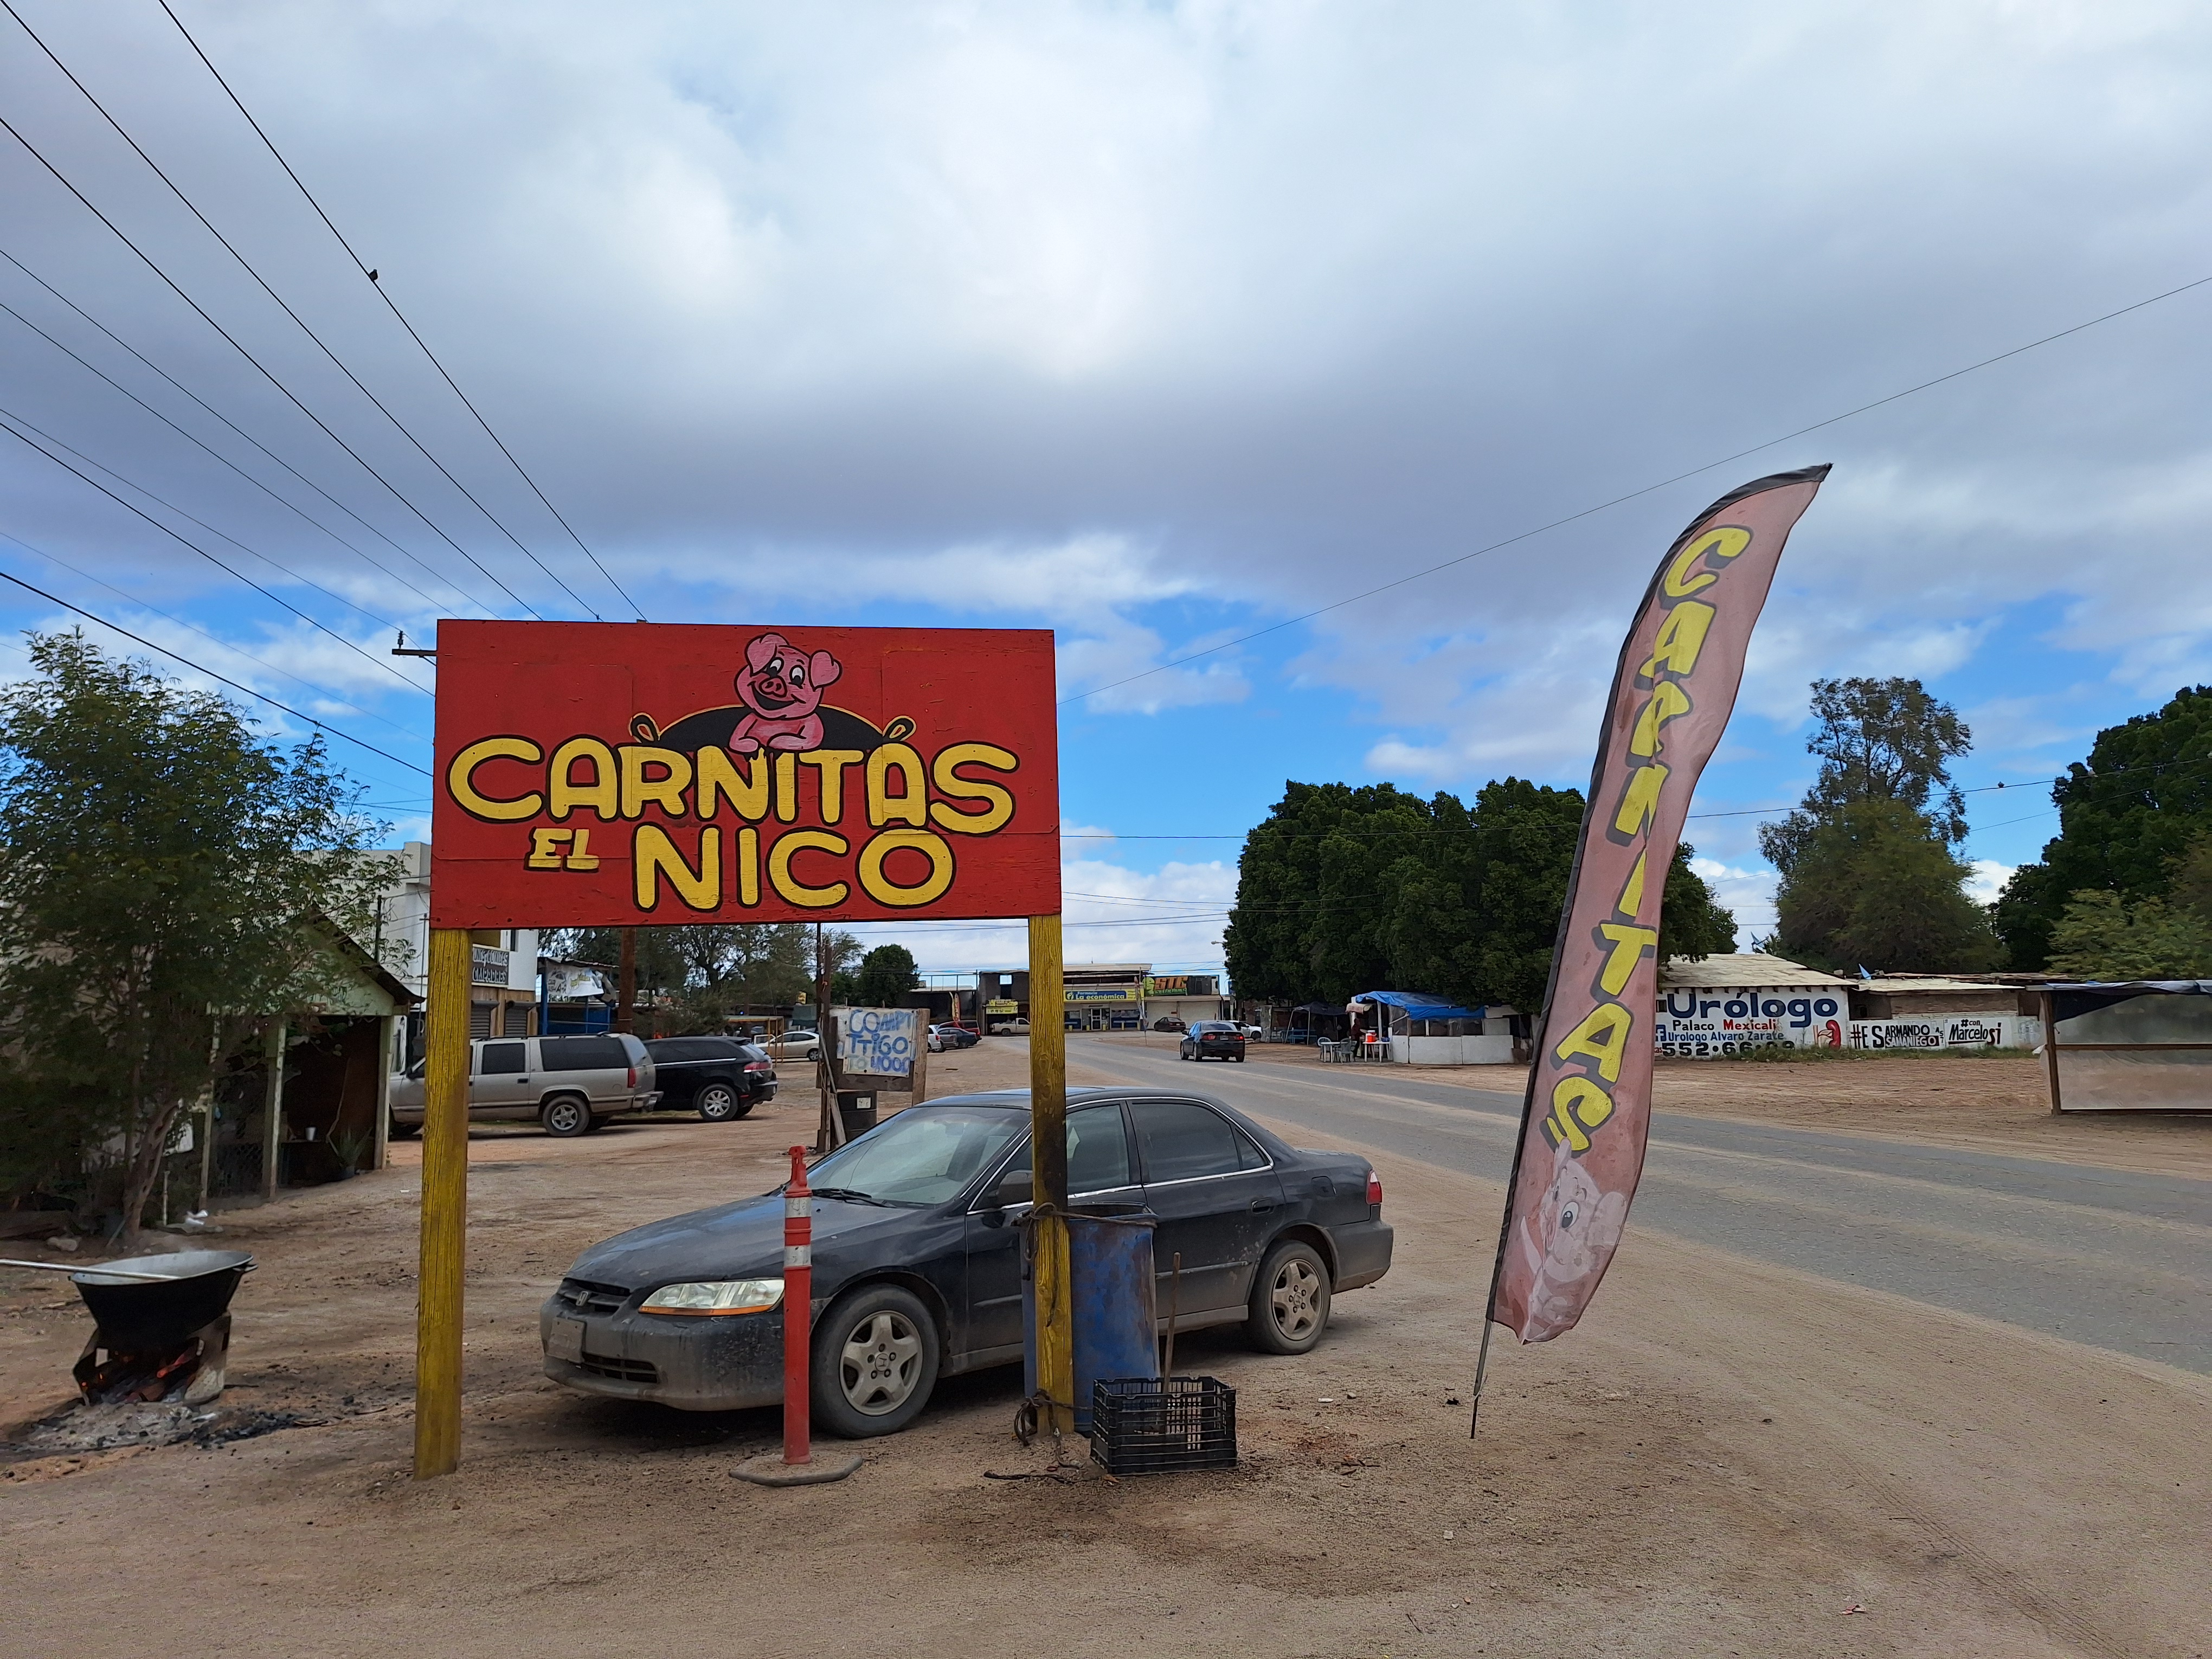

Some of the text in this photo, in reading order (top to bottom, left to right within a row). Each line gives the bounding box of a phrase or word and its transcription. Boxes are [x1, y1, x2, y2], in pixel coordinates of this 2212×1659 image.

[447, 735, 1018, 835] CARNITAS
[525, 827, 600, 871] EL
[1545, 526, 1751, 1152] CARNITAS
[632, 822, 956, 911] NICO
[1667, 992, 1838, 1028] Urólogo
[1673, 1019, 1776, 1031] Palaco Mexicali
[1668, 1032, 1707, 1044] Urologo
[1711, 1031, 1744, 1041] Alvaro
[1885, 1025, 1930, 1037] ARMANDO
[1886, 1036, 1937, 1047] SAMANIEGO
